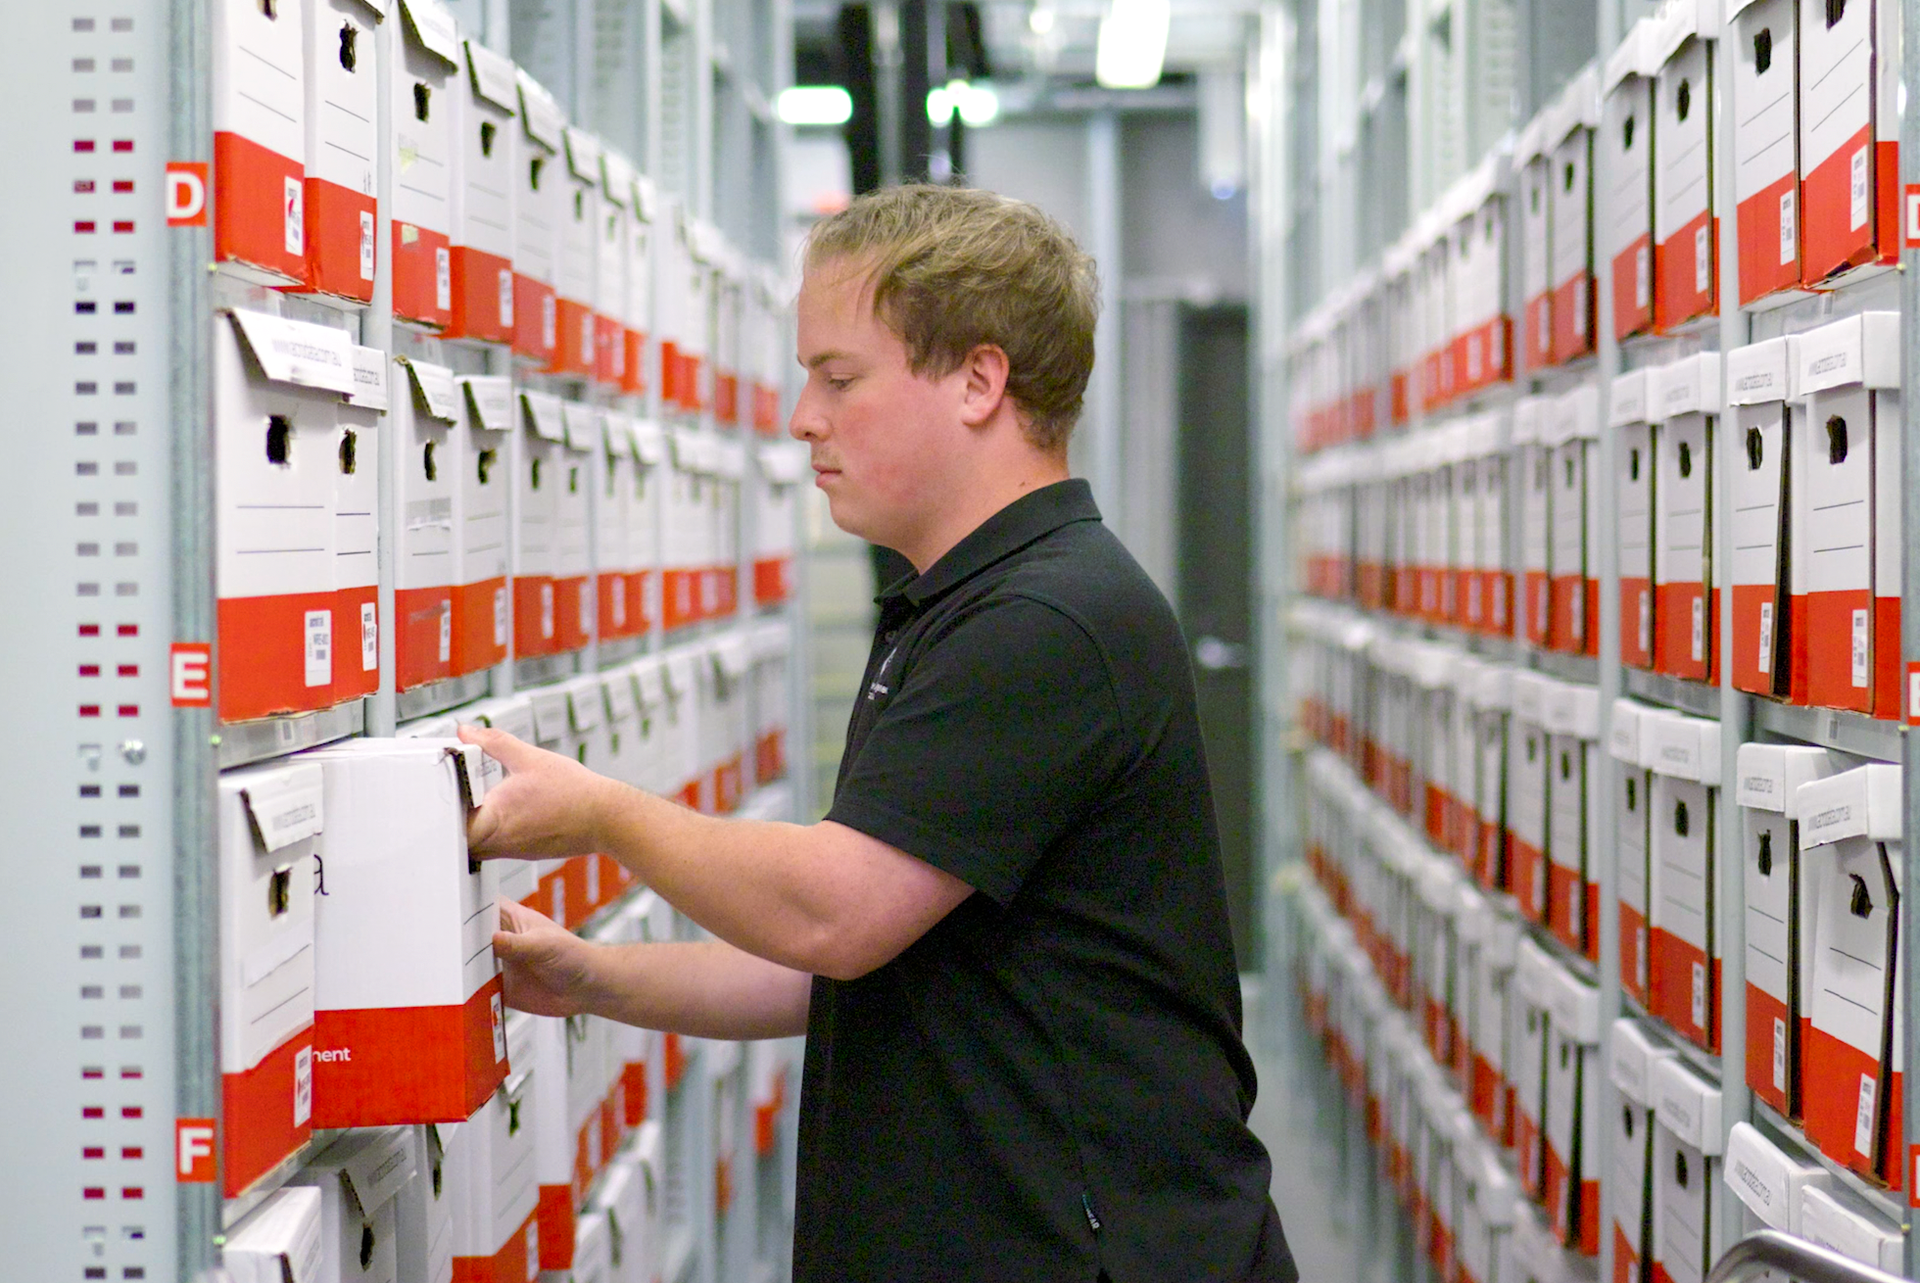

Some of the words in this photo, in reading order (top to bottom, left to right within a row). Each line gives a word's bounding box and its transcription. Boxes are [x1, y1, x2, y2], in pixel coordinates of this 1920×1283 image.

[166, 171, 205, 219] D
[173, 652, 209, 699] E
[180, 1127, 213, 1175] F
